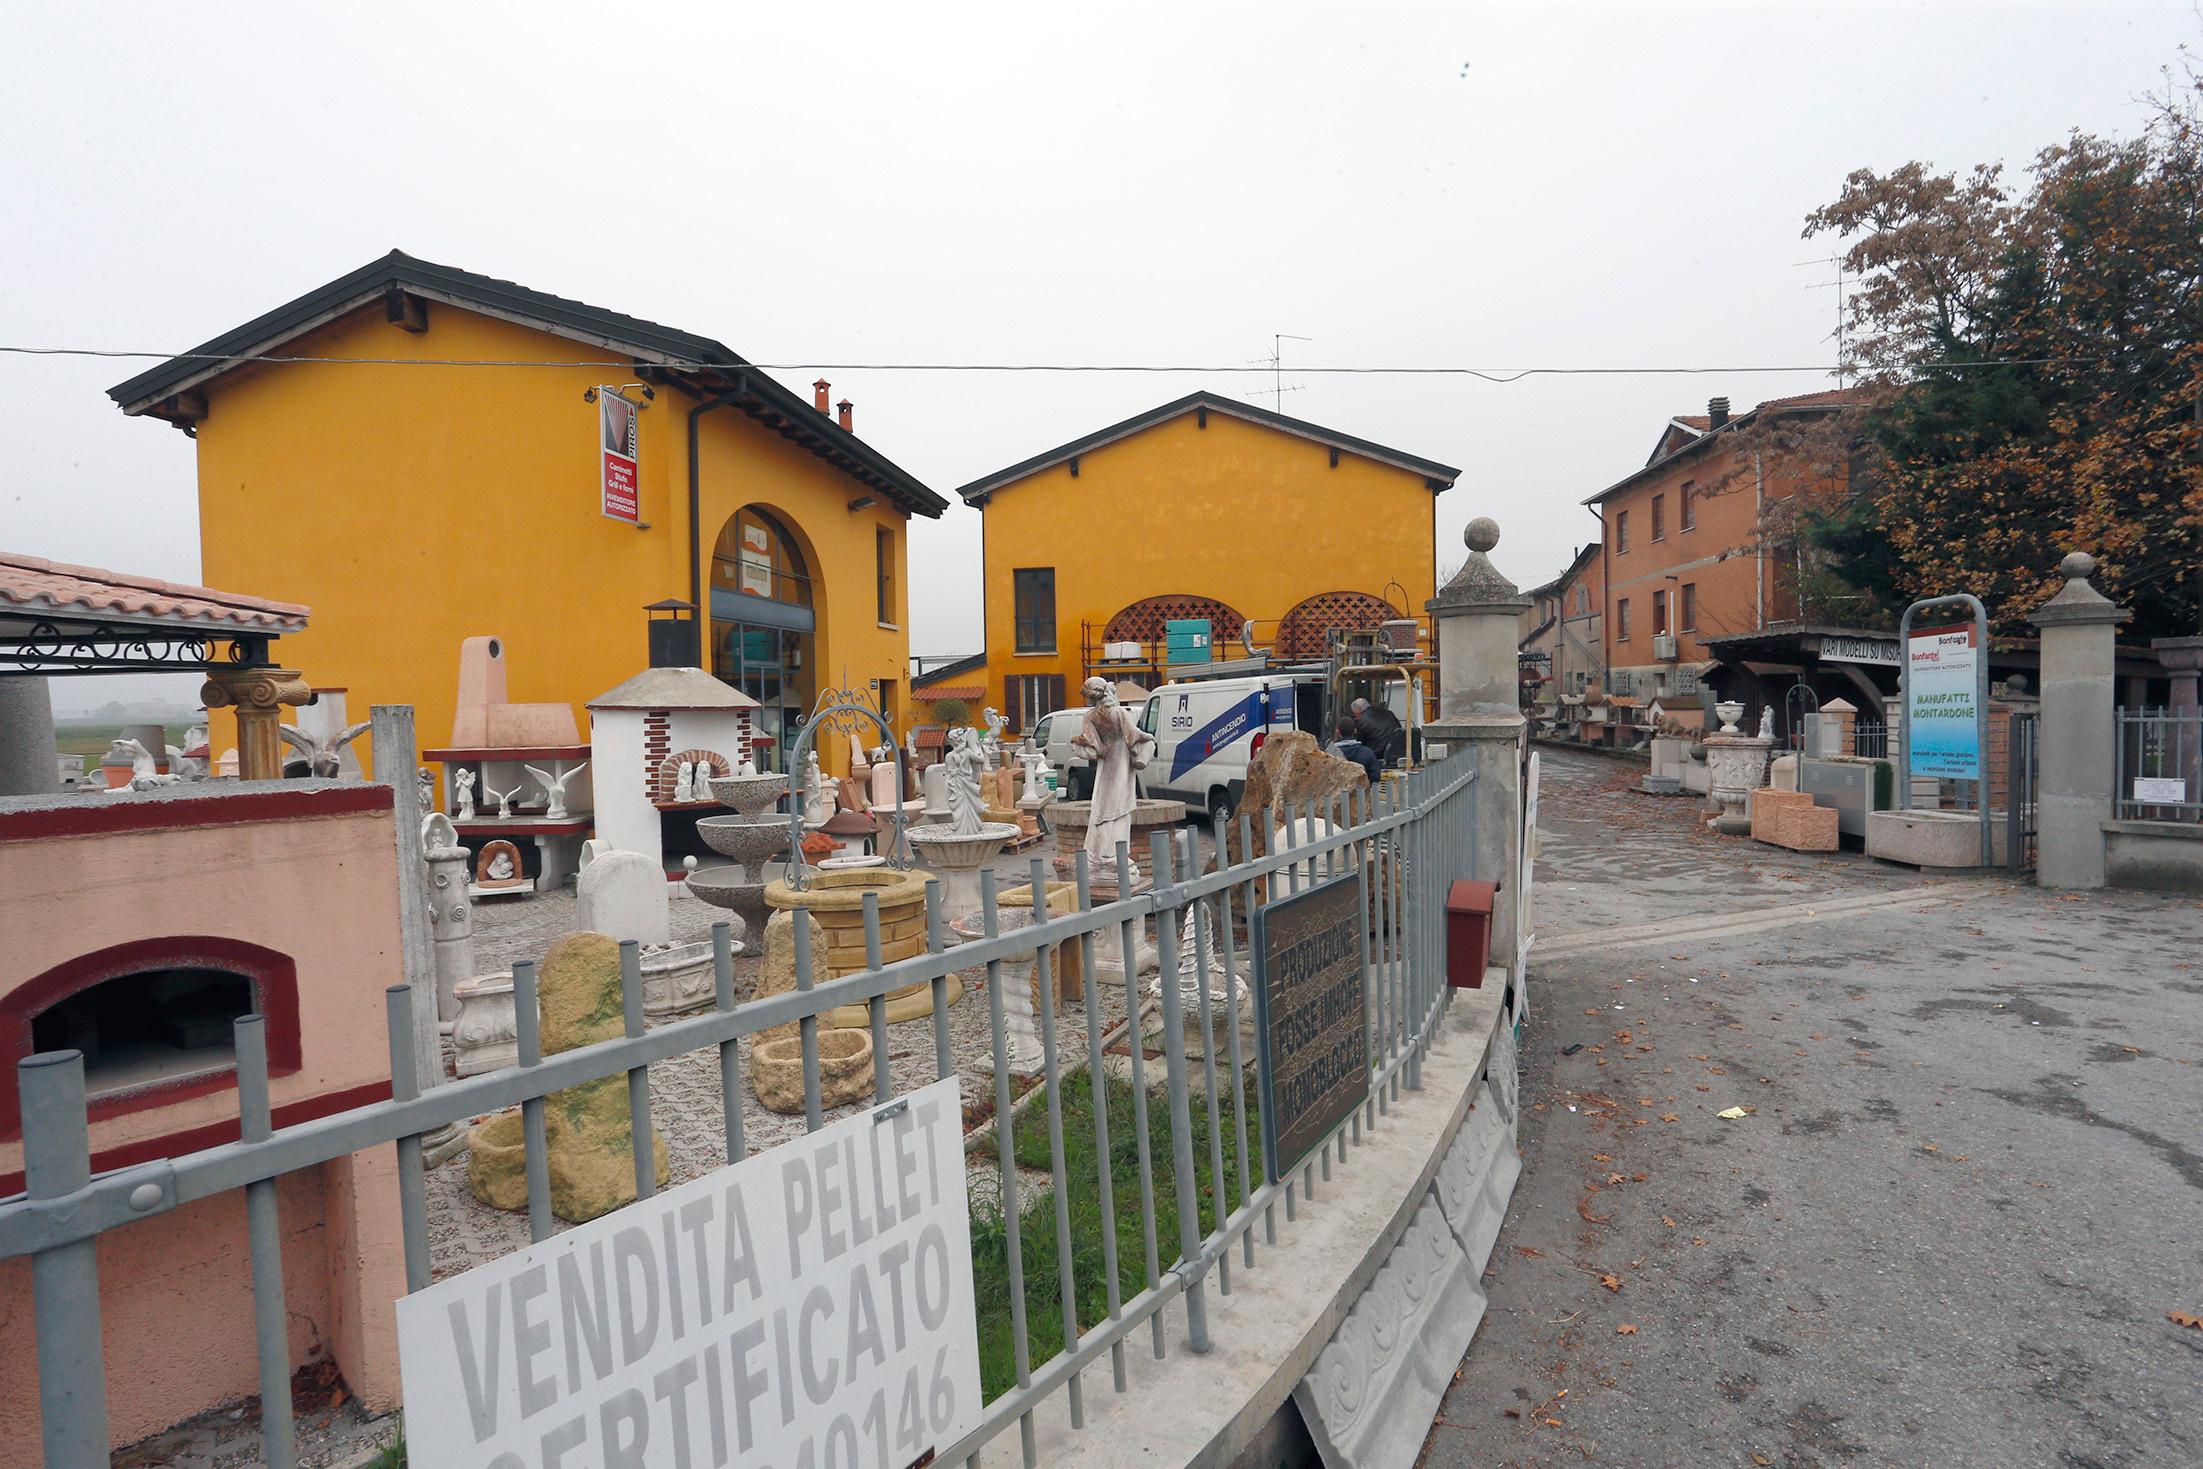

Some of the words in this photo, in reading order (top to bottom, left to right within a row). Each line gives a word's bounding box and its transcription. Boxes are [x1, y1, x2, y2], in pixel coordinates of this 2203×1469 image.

[1822, 640, 1838, 656] VARI
[1840, 641, 1869, 659] MODELLI
[1870, 643, 1880, 660] SU
[1913, 707, 1975, 719] MONTARDONE
[1917, 692, 1970, 705] MANUFATTI
[1211, 713, 1246, 743] ANTINCENDIO
[1279, 921, 1352, 993] PRODUZIONE
[1279, 999, 1318, 1060] FOSSE
[1320, 974, 1360, 1031] IMHOFF
[1283, 1029, 1362, 1125] MONOBLOCCO
[447, 1182, 763, 1444] VENDITA
[781, 1100, 941, 1280] PELLET
